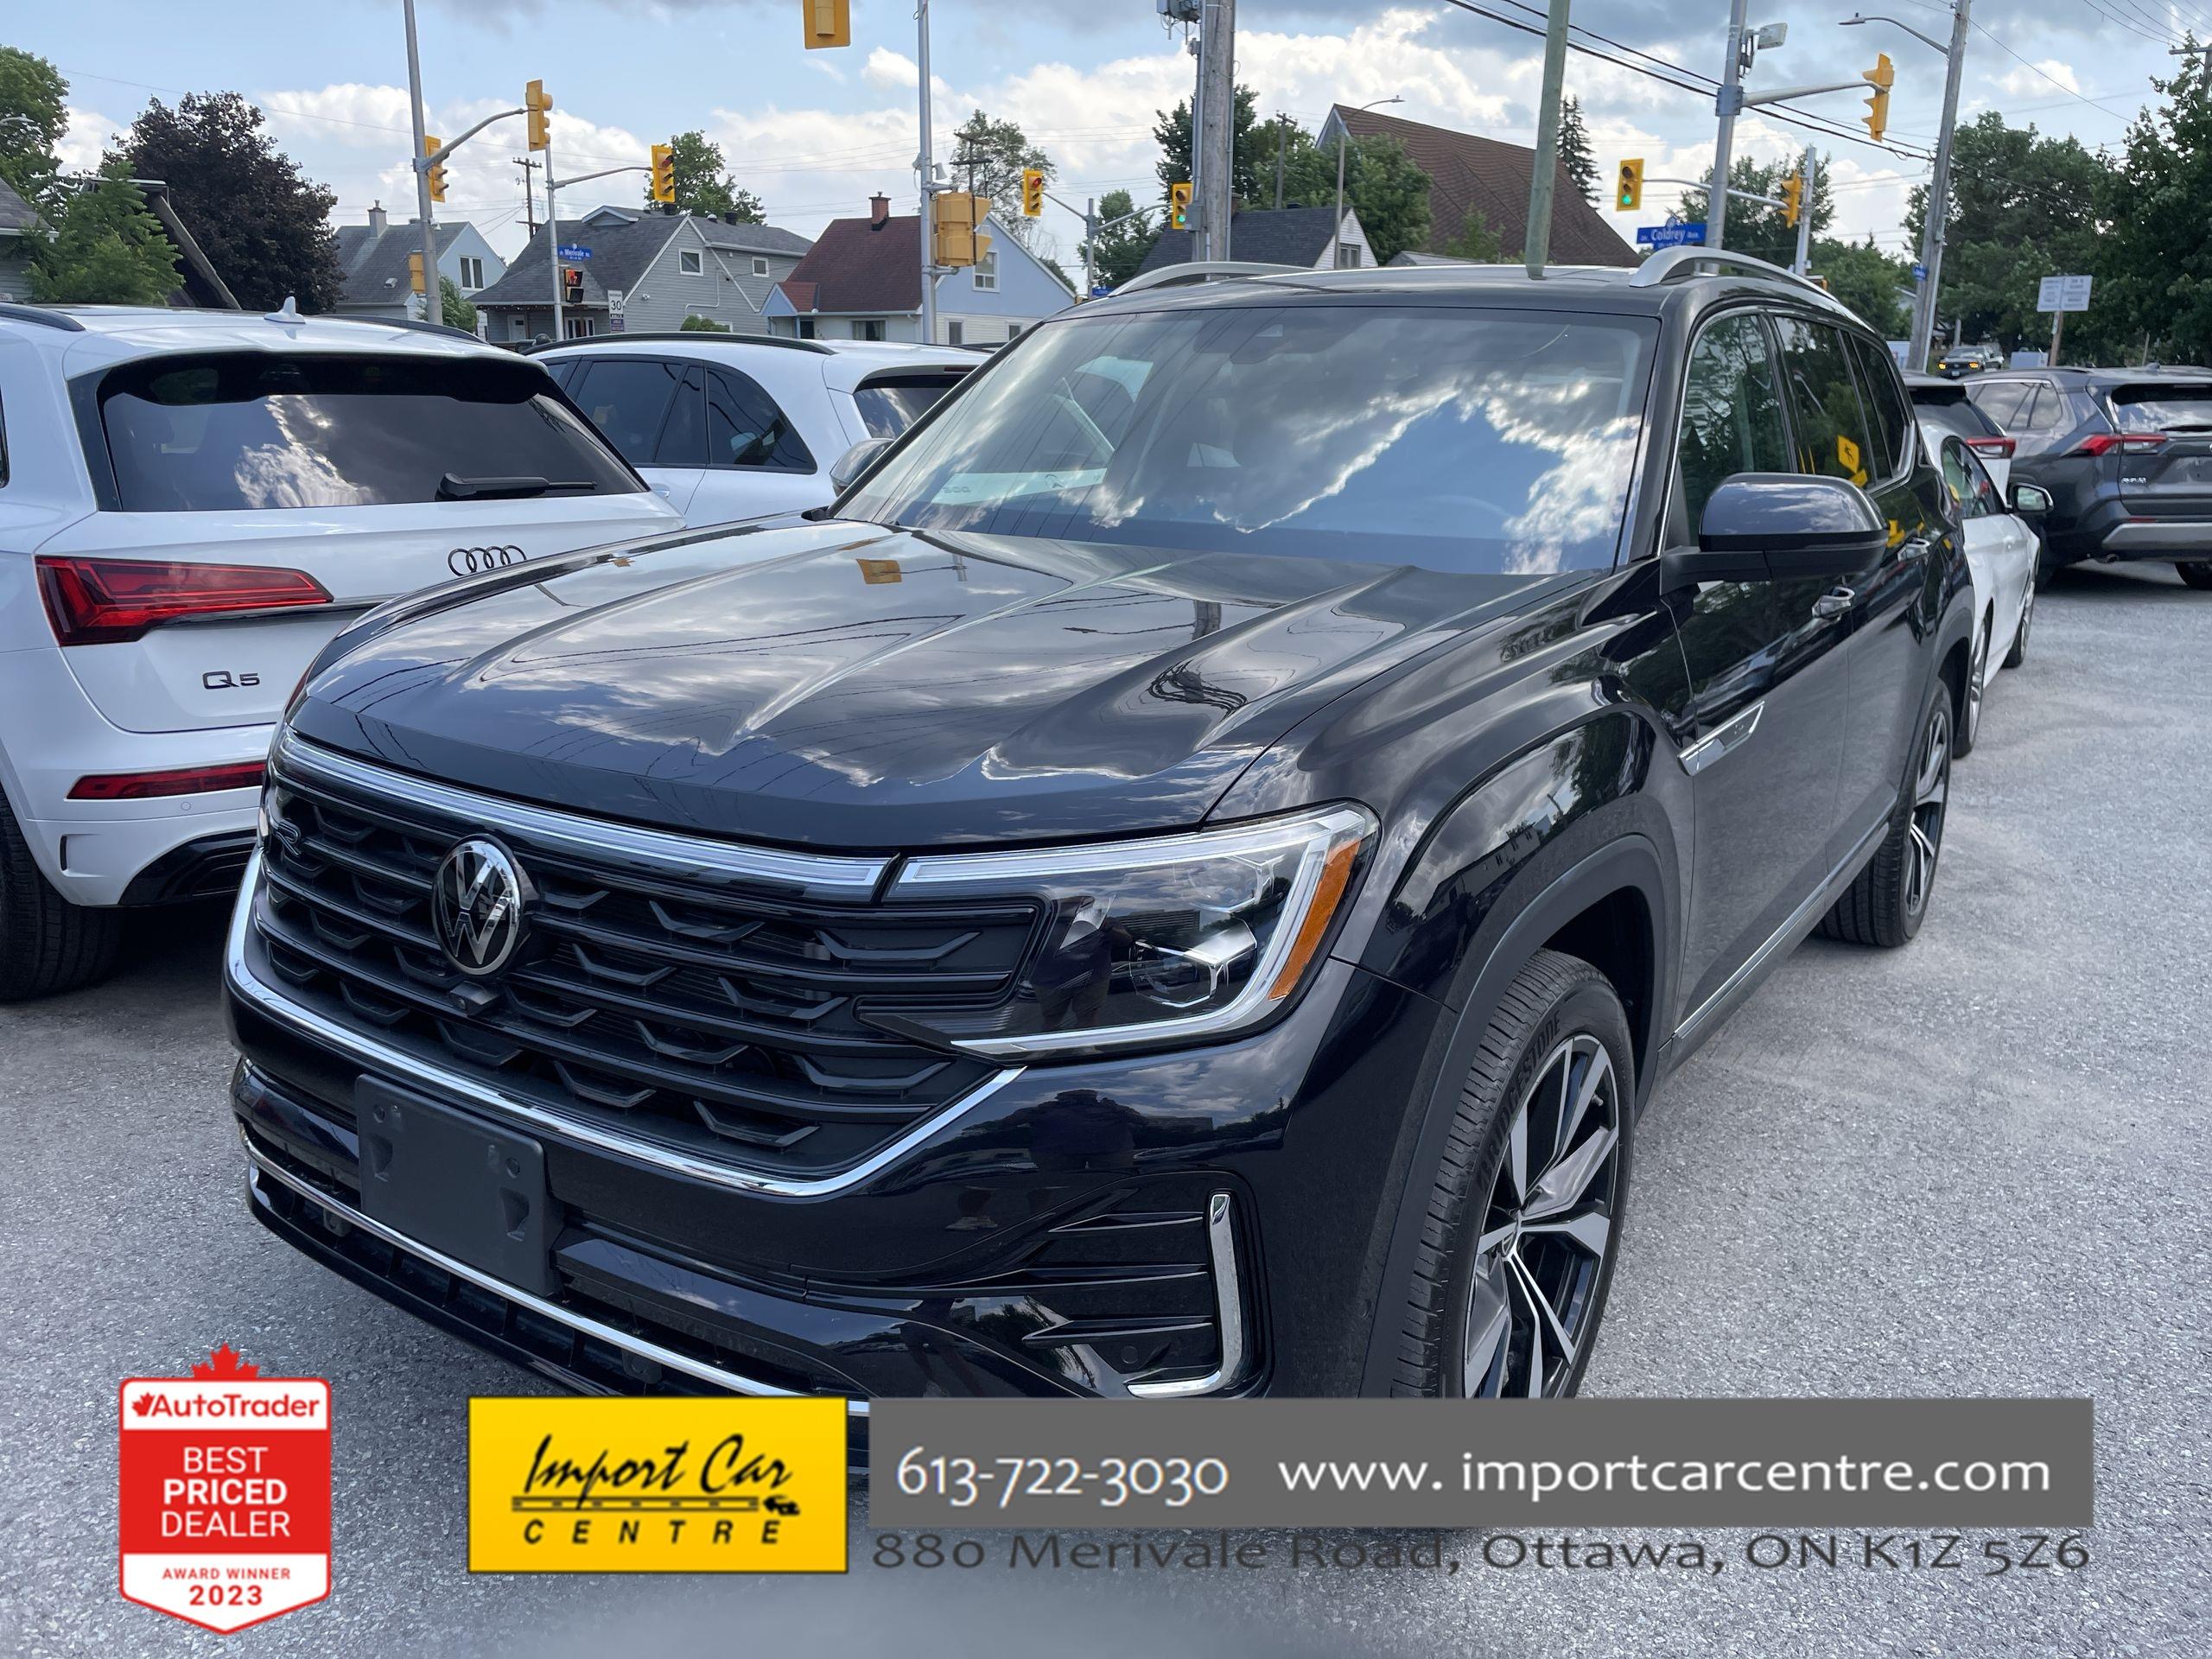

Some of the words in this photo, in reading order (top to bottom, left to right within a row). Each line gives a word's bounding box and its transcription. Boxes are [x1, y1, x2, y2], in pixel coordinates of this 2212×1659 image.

[1650, 228, 1686, 243] Coldrey
[611, 300, 622, 310] 30
[202, 671, 260, 690] Q5
[1477, 1008, 1561, 1192] BRIDGESTONE
